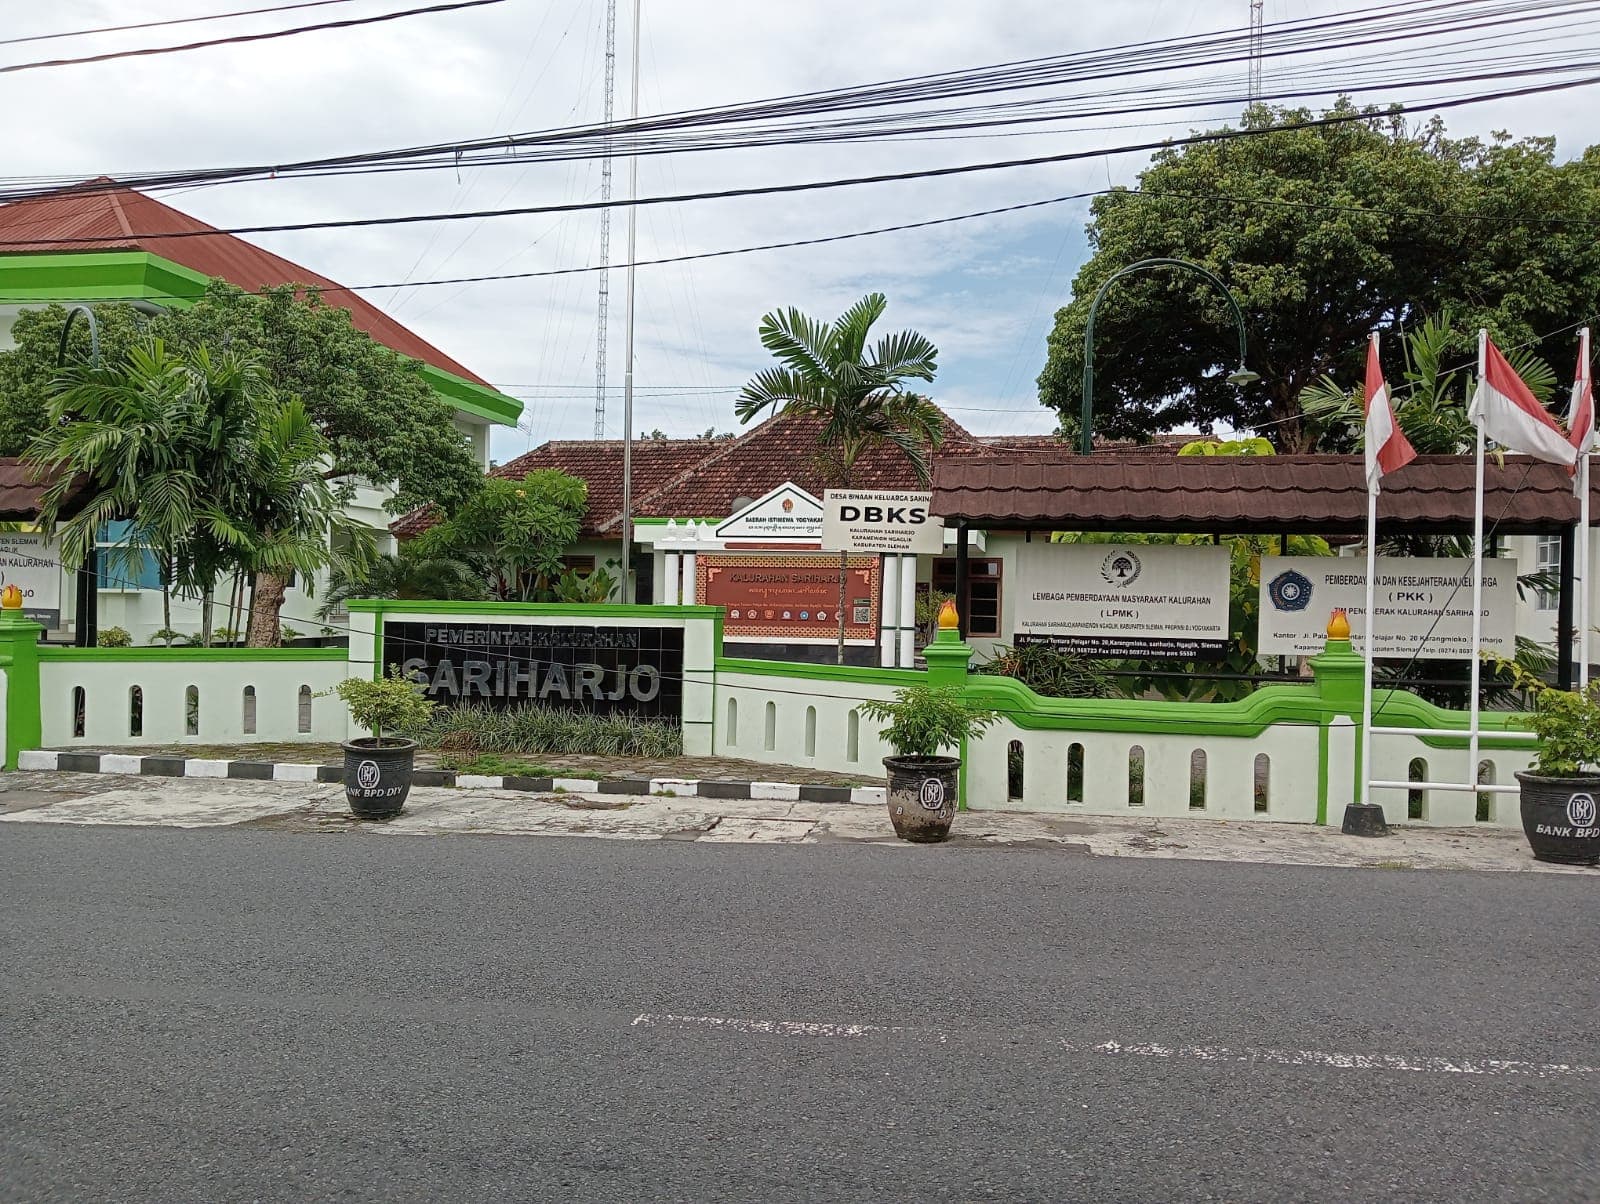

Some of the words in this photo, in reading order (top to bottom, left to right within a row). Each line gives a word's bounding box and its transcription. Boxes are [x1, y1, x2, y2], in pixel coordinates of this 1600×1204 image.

[840, 506, 926, 524] DBKS
[8, 558, 54, 568] KALURAHAN
[1382, 576, 1397, 586] DAN
[1398, 576, 1458, 588] KESEJAHTERAAN
[1032, 592, 1065, 601] LEMBAGA
[1066, 593, 1120, 603] PEMBERDAYAAN
[1121, 594, 1167, 604] MASYARAKAT
[1168, 595, 1212, 605] KALURAHAN
[1396, 592, 1425, 602] PKK
[1106, 609, 1134, 618] LPMK
[1397, 608, 1444, 616] KALURAHAN
[1445, 609, 1490, 617] SARIHAJO
[426, 628, 532, 646] PEMERINTAH
[535, 632, 637, 649] KALURAHAN
[402, 657, 660, 702] SARIHARJO
[363, 789, 385, 798] BPD
[386, 784, 403, 797] DIY
[1536, 824, 1572, 837] BANK
[1575, 827, 1600, 838] BPD
